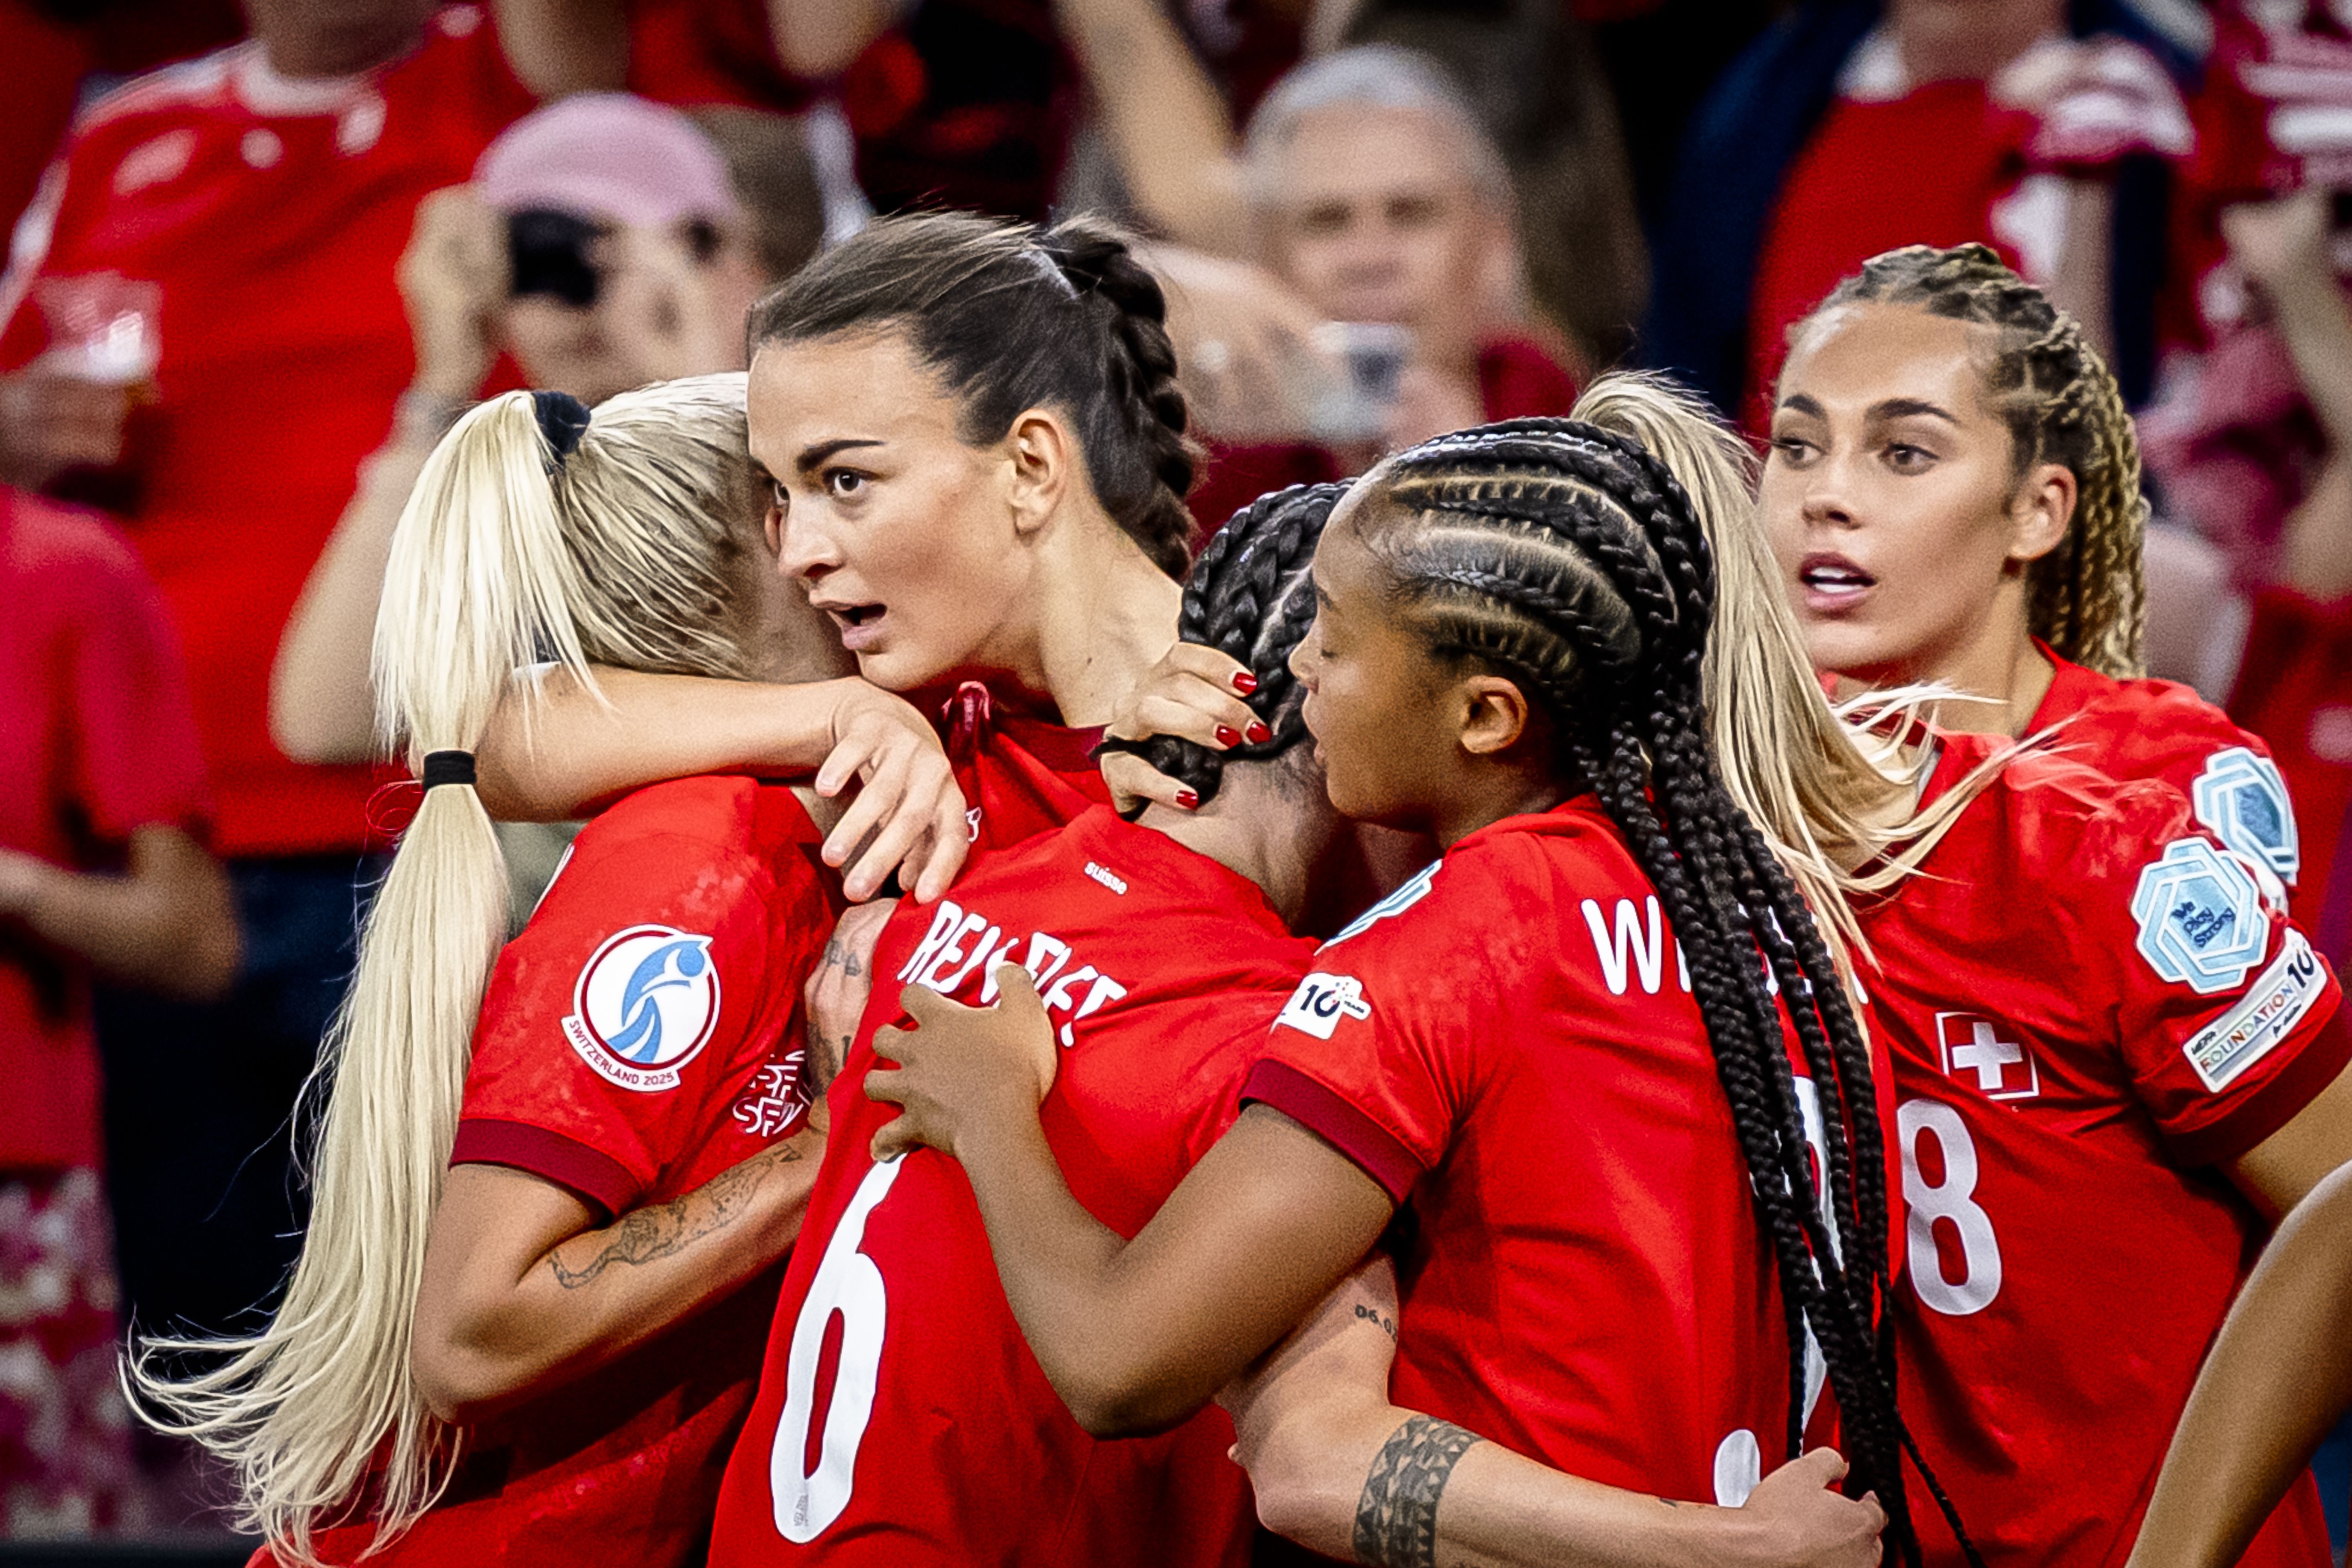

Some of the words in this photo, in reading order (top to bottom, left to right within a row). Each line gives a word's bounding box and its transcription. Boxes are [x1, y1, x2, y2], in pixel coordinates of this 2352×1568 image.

[1084, 862, 1127, 894] suisse
[570, 1020, 639, 1085] SWITZERLAND
[643, 1072, 674, 1086] 2025
[2199, 985, 2294, 1072] FOUNDATION
[1897, 1098, 2002, 1316] 8
[771, 1151, 909, 1544] 6
